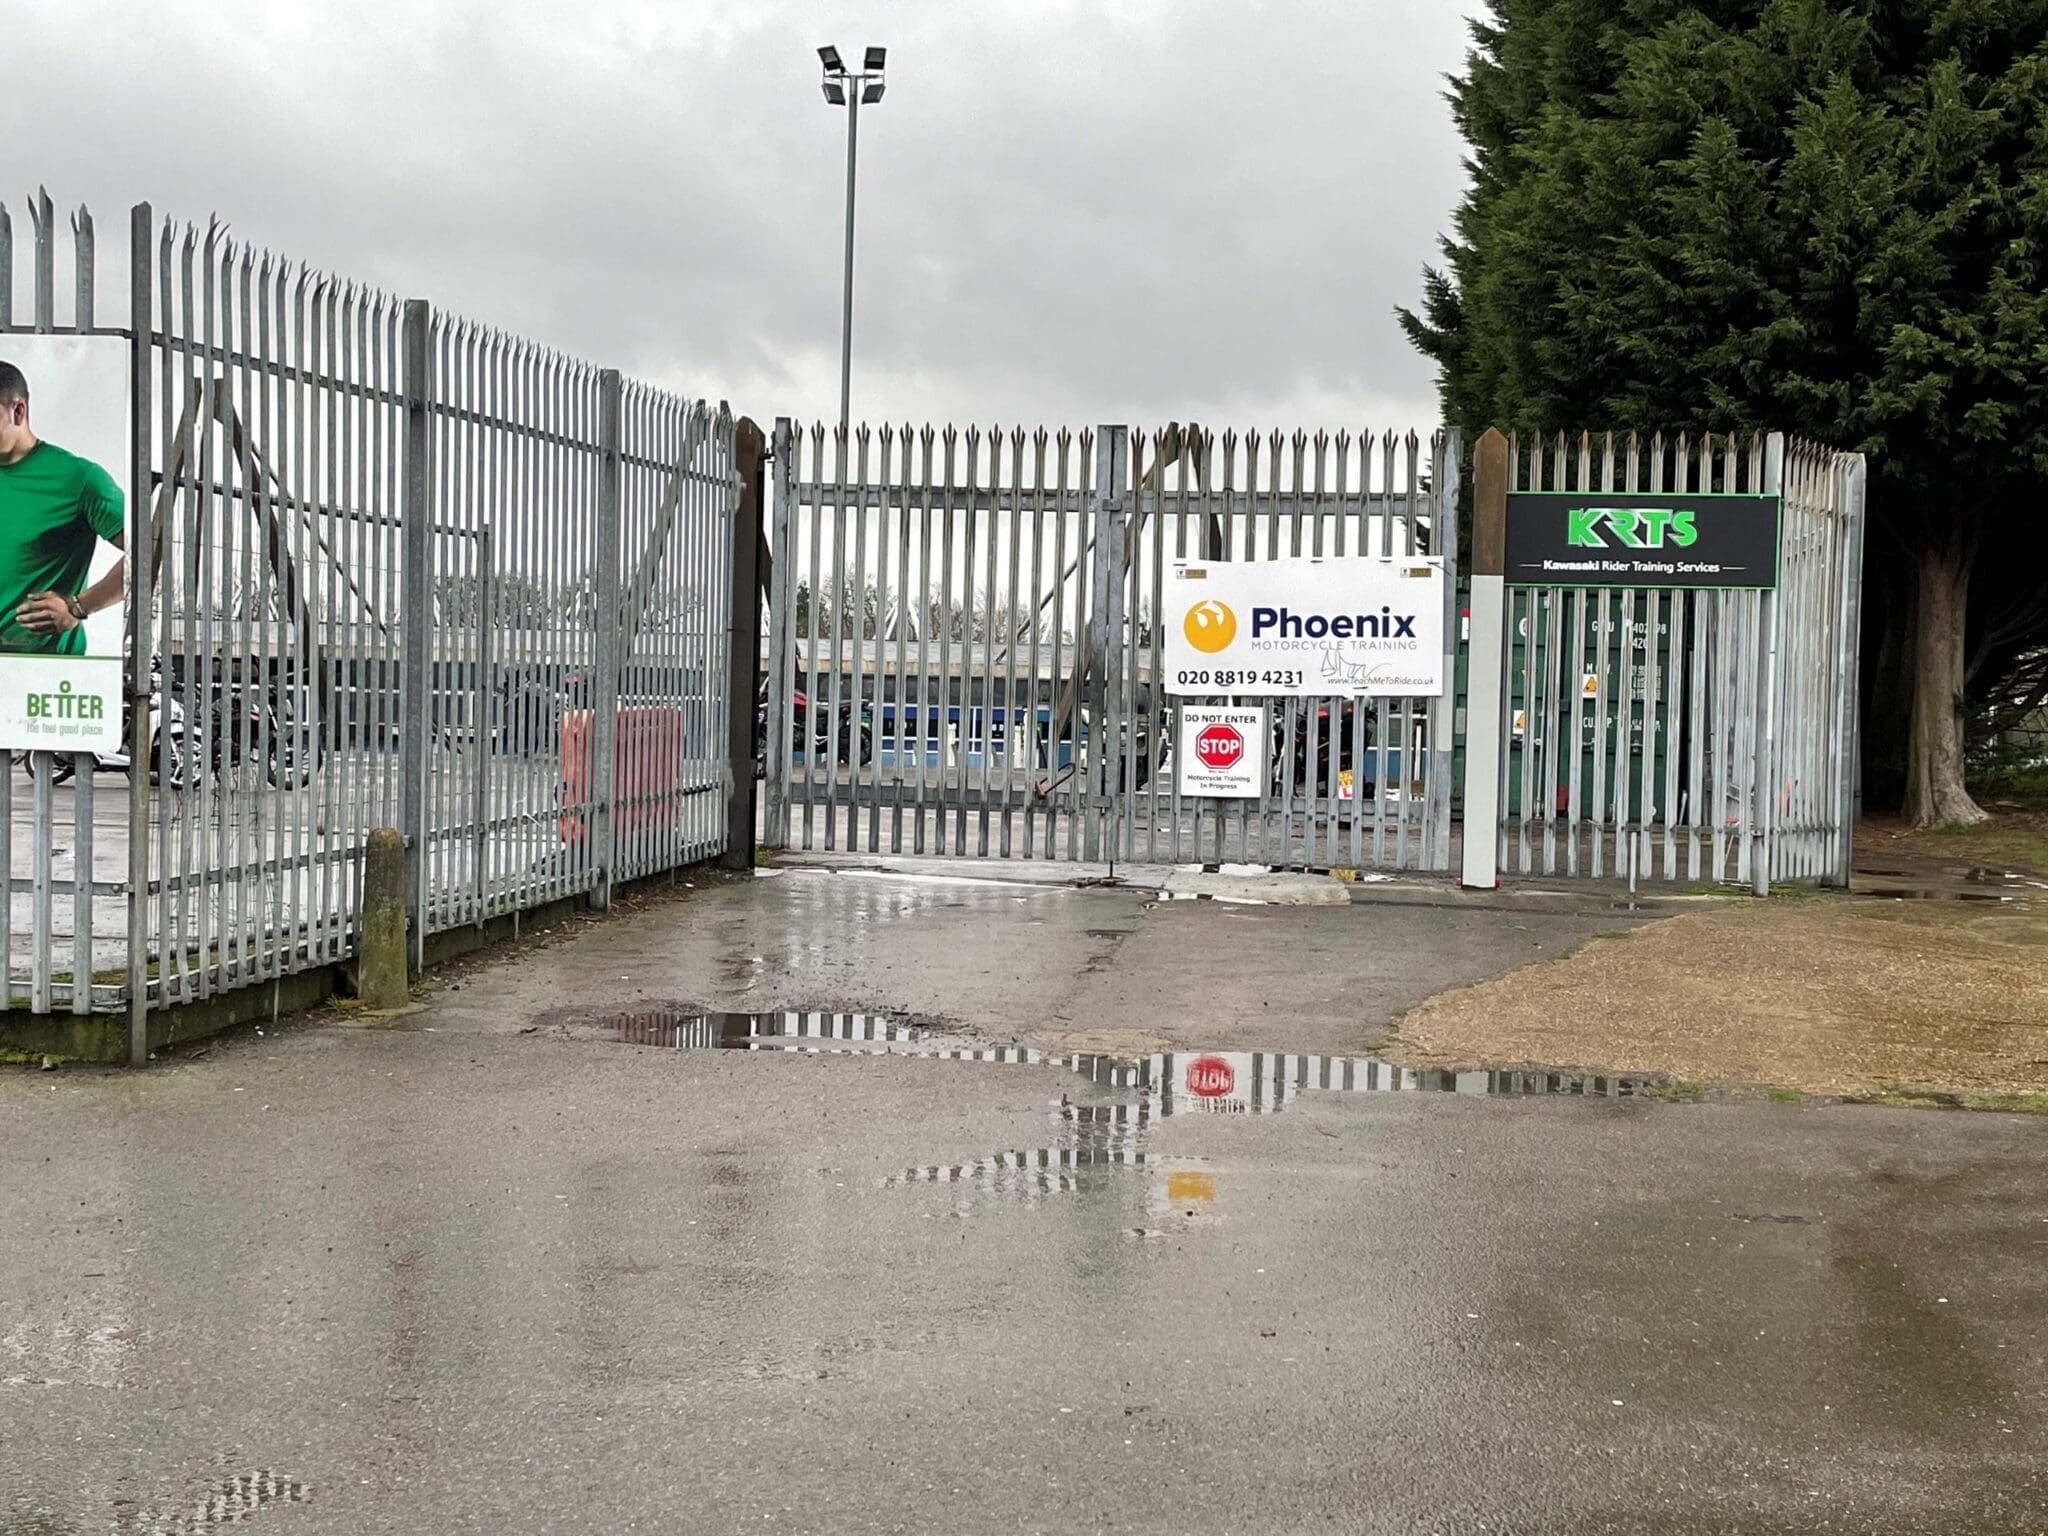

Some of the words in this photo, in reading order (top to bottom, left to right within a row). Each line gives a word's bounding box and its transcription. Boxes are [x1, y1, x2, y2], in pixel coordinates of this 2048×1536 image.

[1568, 508, 1698, 548] KRTS
[1543, 559, 1600, 571] Kawasaki
[1602, 560, 1631, 571] Rider
[1632, 561, 1675, 574] Training
[1676, 562, 1720, 573] Services
[1252, 606, 1416, 638] Phoenix
[1251, 640, 1344, 650] MOTORCYCLE
[1350, 640, 1417, 650] TRAINING
[1177, 670, 1210, 684] 020
[1214, 670, 1257, 684] 8819
[1261, 670, 1303, 684] 4231
[27, 693, 103, 719] BETTER
[1185, 714, 1199, 722] DO
[1201, 714, 1222, 723] NOT
[1225, 715, 1257, 724] ENTER
[1200, 738, 1240, 754] STOP
[1187, 774, 1222, 782] Motorcycle
[1224, 775, 1251, 783] Training
